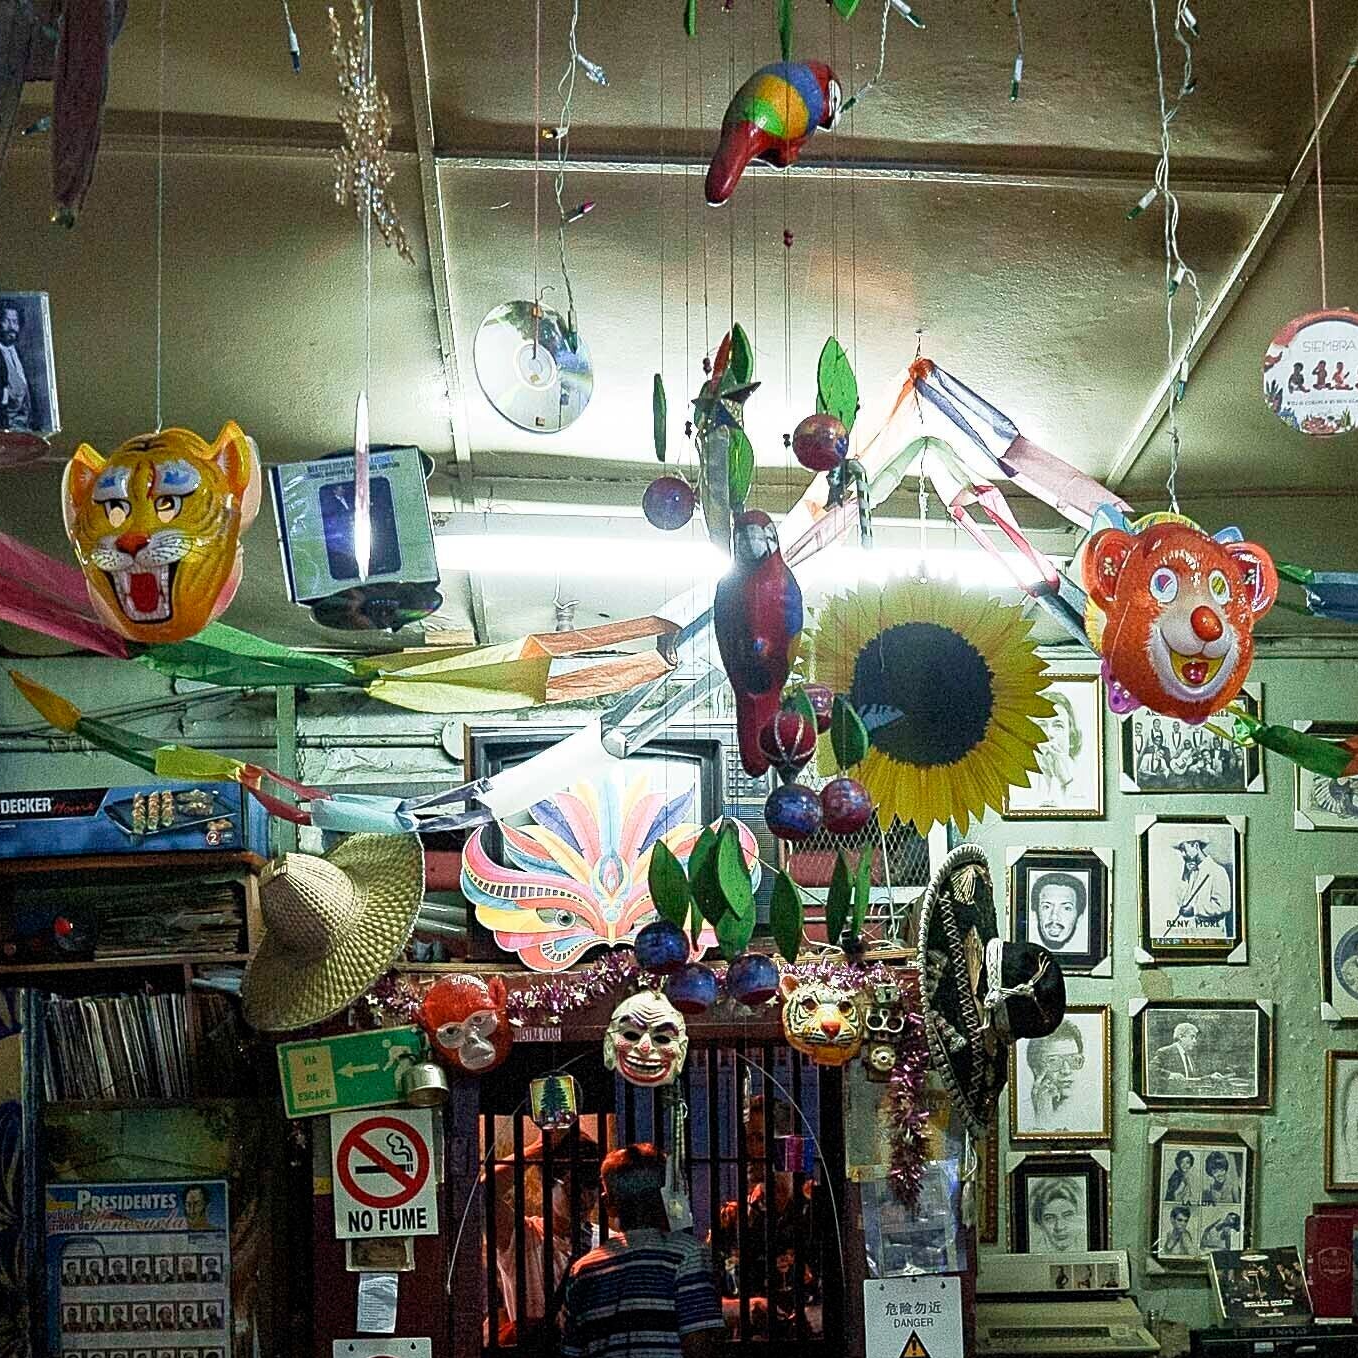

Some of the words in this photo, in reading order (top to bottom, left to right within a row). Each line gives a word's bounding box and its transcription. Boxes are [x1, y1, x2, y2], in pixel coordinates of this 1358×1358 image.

[1302, 339, 1357, 353] SIEMBRA
[303, 1055, 318, 1066] VIA
[305, 1072, 318, 1083] DE
[297, 1088, 332, 1101] ESCAPE
[77, 1189, 178, 1210] PRESIDENTES
[348, 1210, 373, 1232] NO
[379, 1207, 427, 1231] FUME
[885, 1301, 942, 1316] 危险勿近
[894, 1317, 934, 1328] DANGER
